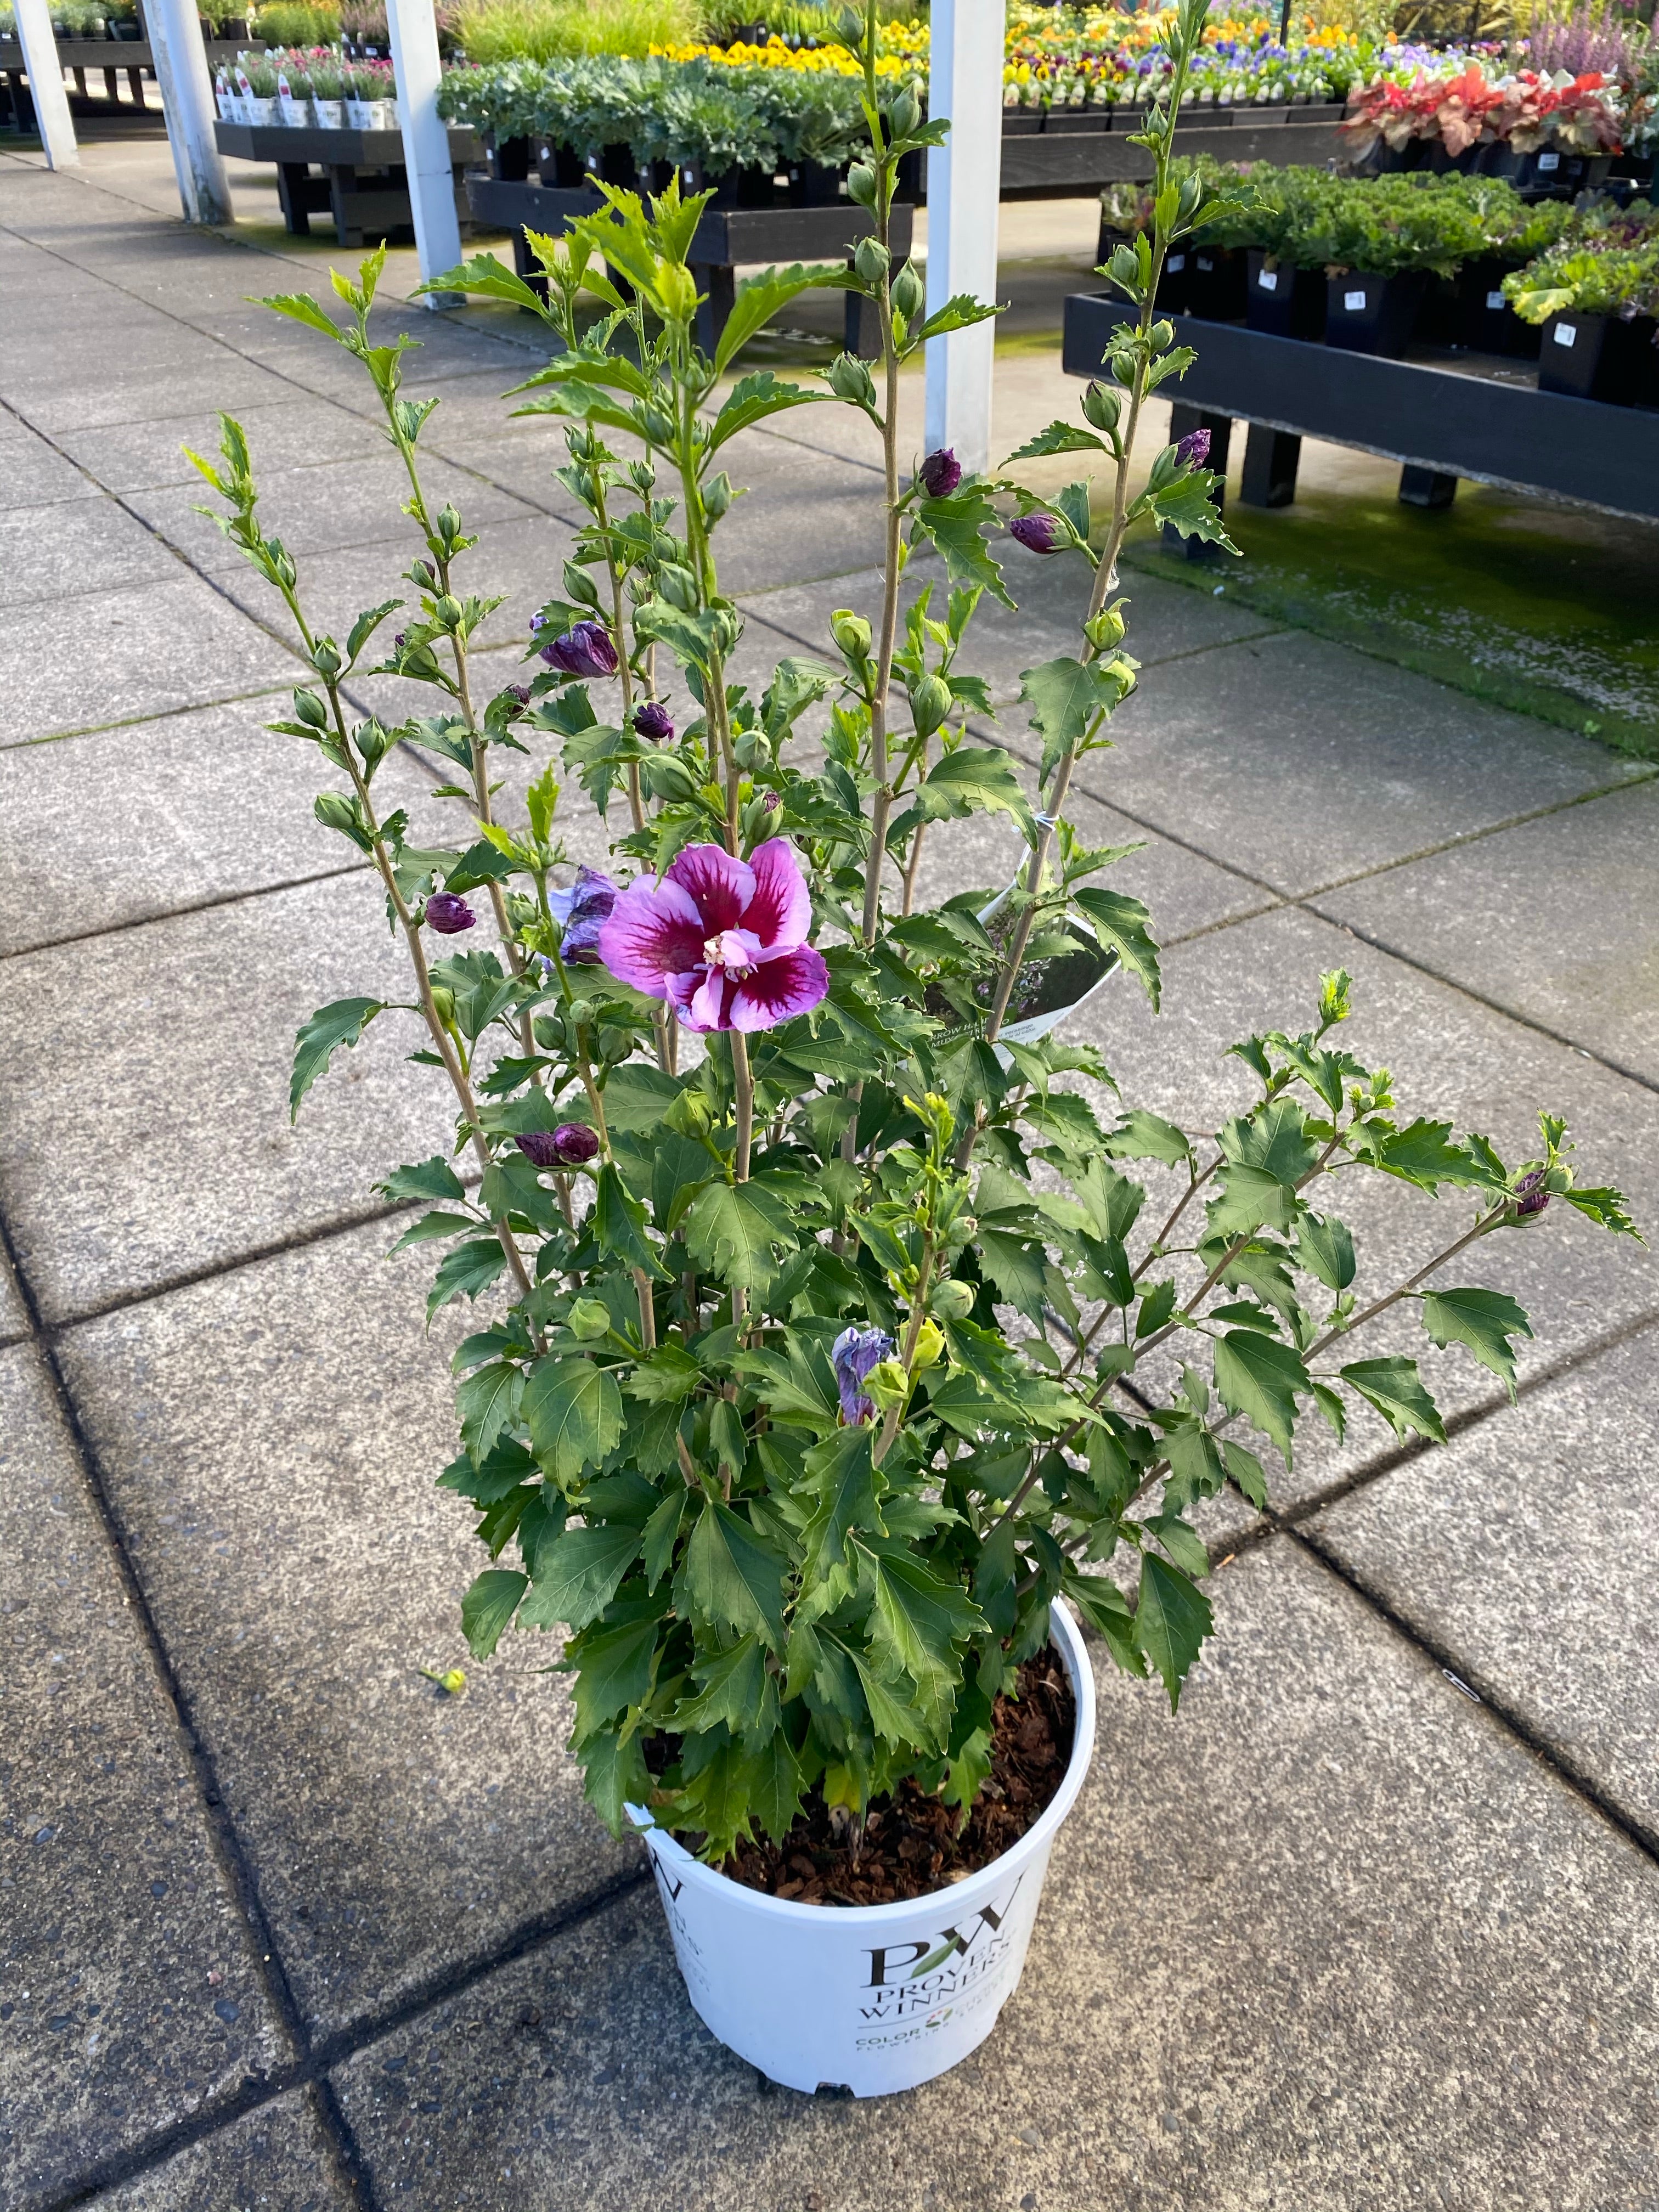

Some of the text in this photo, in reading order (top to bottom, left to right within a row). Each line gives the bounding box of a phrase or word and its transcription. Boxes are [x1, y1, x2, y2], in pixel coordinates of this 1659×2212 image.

[860, 1865, 1029, 1989] PW
[876, 1925, 1007, 2004] PROVEN
[857, 1942, 1010, 2020] WINNERS
[855, 2028, 921, 2046] COLOR
